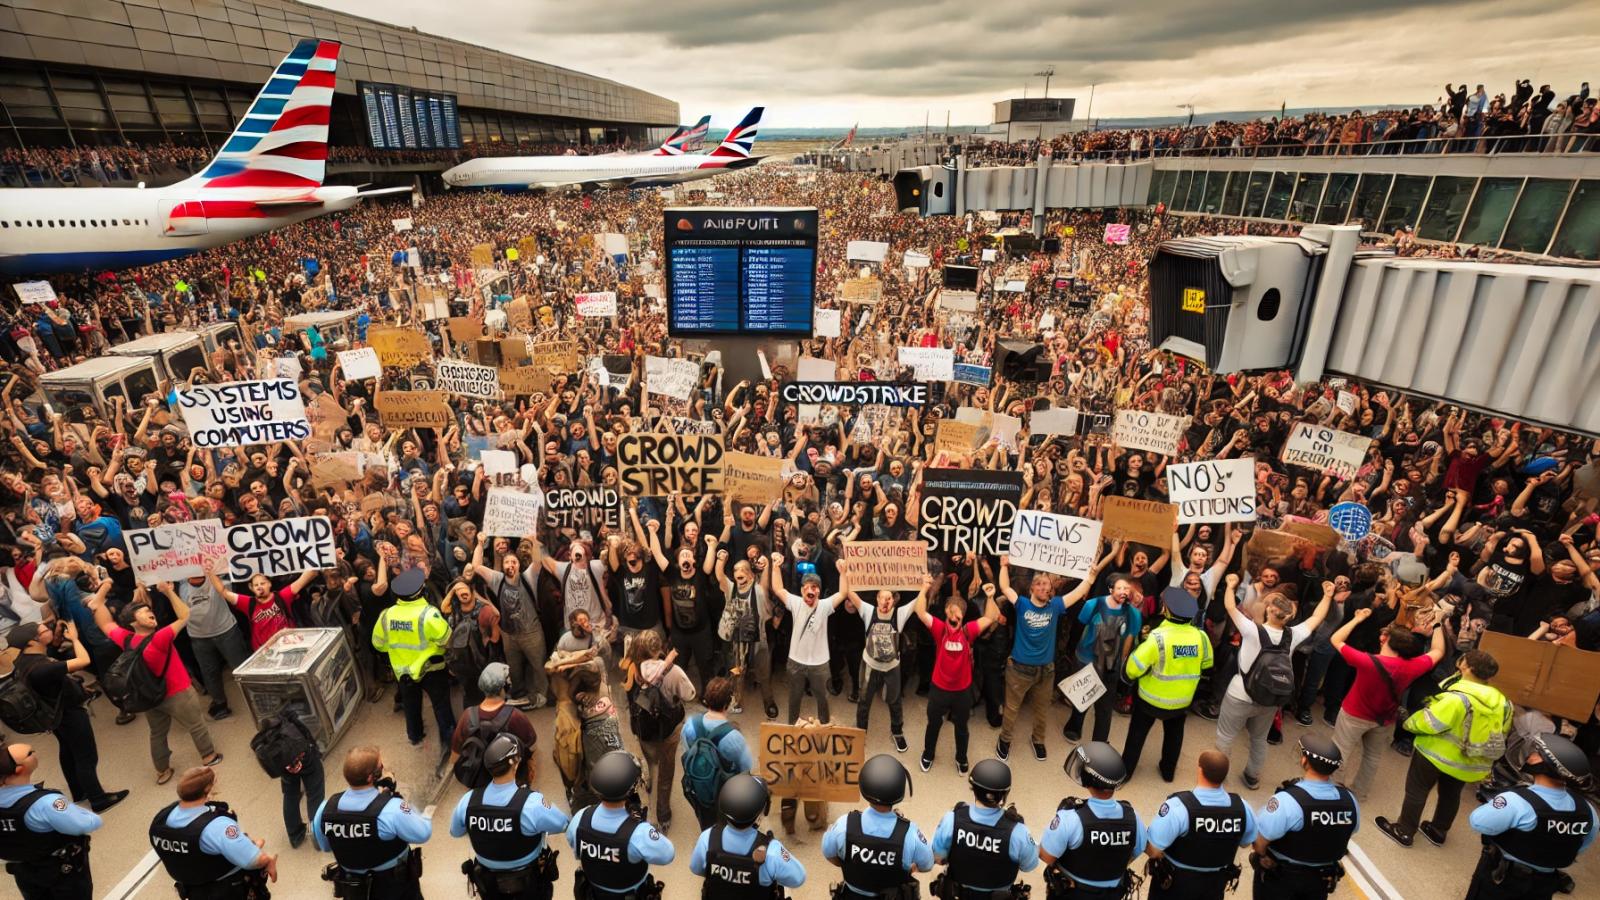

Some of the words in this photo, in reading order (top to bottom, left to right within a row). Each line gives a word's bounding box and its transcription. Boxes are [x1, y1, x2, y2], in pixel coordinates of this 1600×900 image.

[783, 384, 928, 404] CROWDSTRIKE
[211, 403, 273, 424] USING
[618, 435, 723, 465] CROWD
[546, 485, 618, 508] CROWD
[921, 496, 1017, 527] CROWD
[228, 518, 331, 552] CROWD
[919, 523, 1011, 556] STRIKE
[1019, 514, 1091, 544] NEWS
[230, 543, 335, 580] STRIKE
